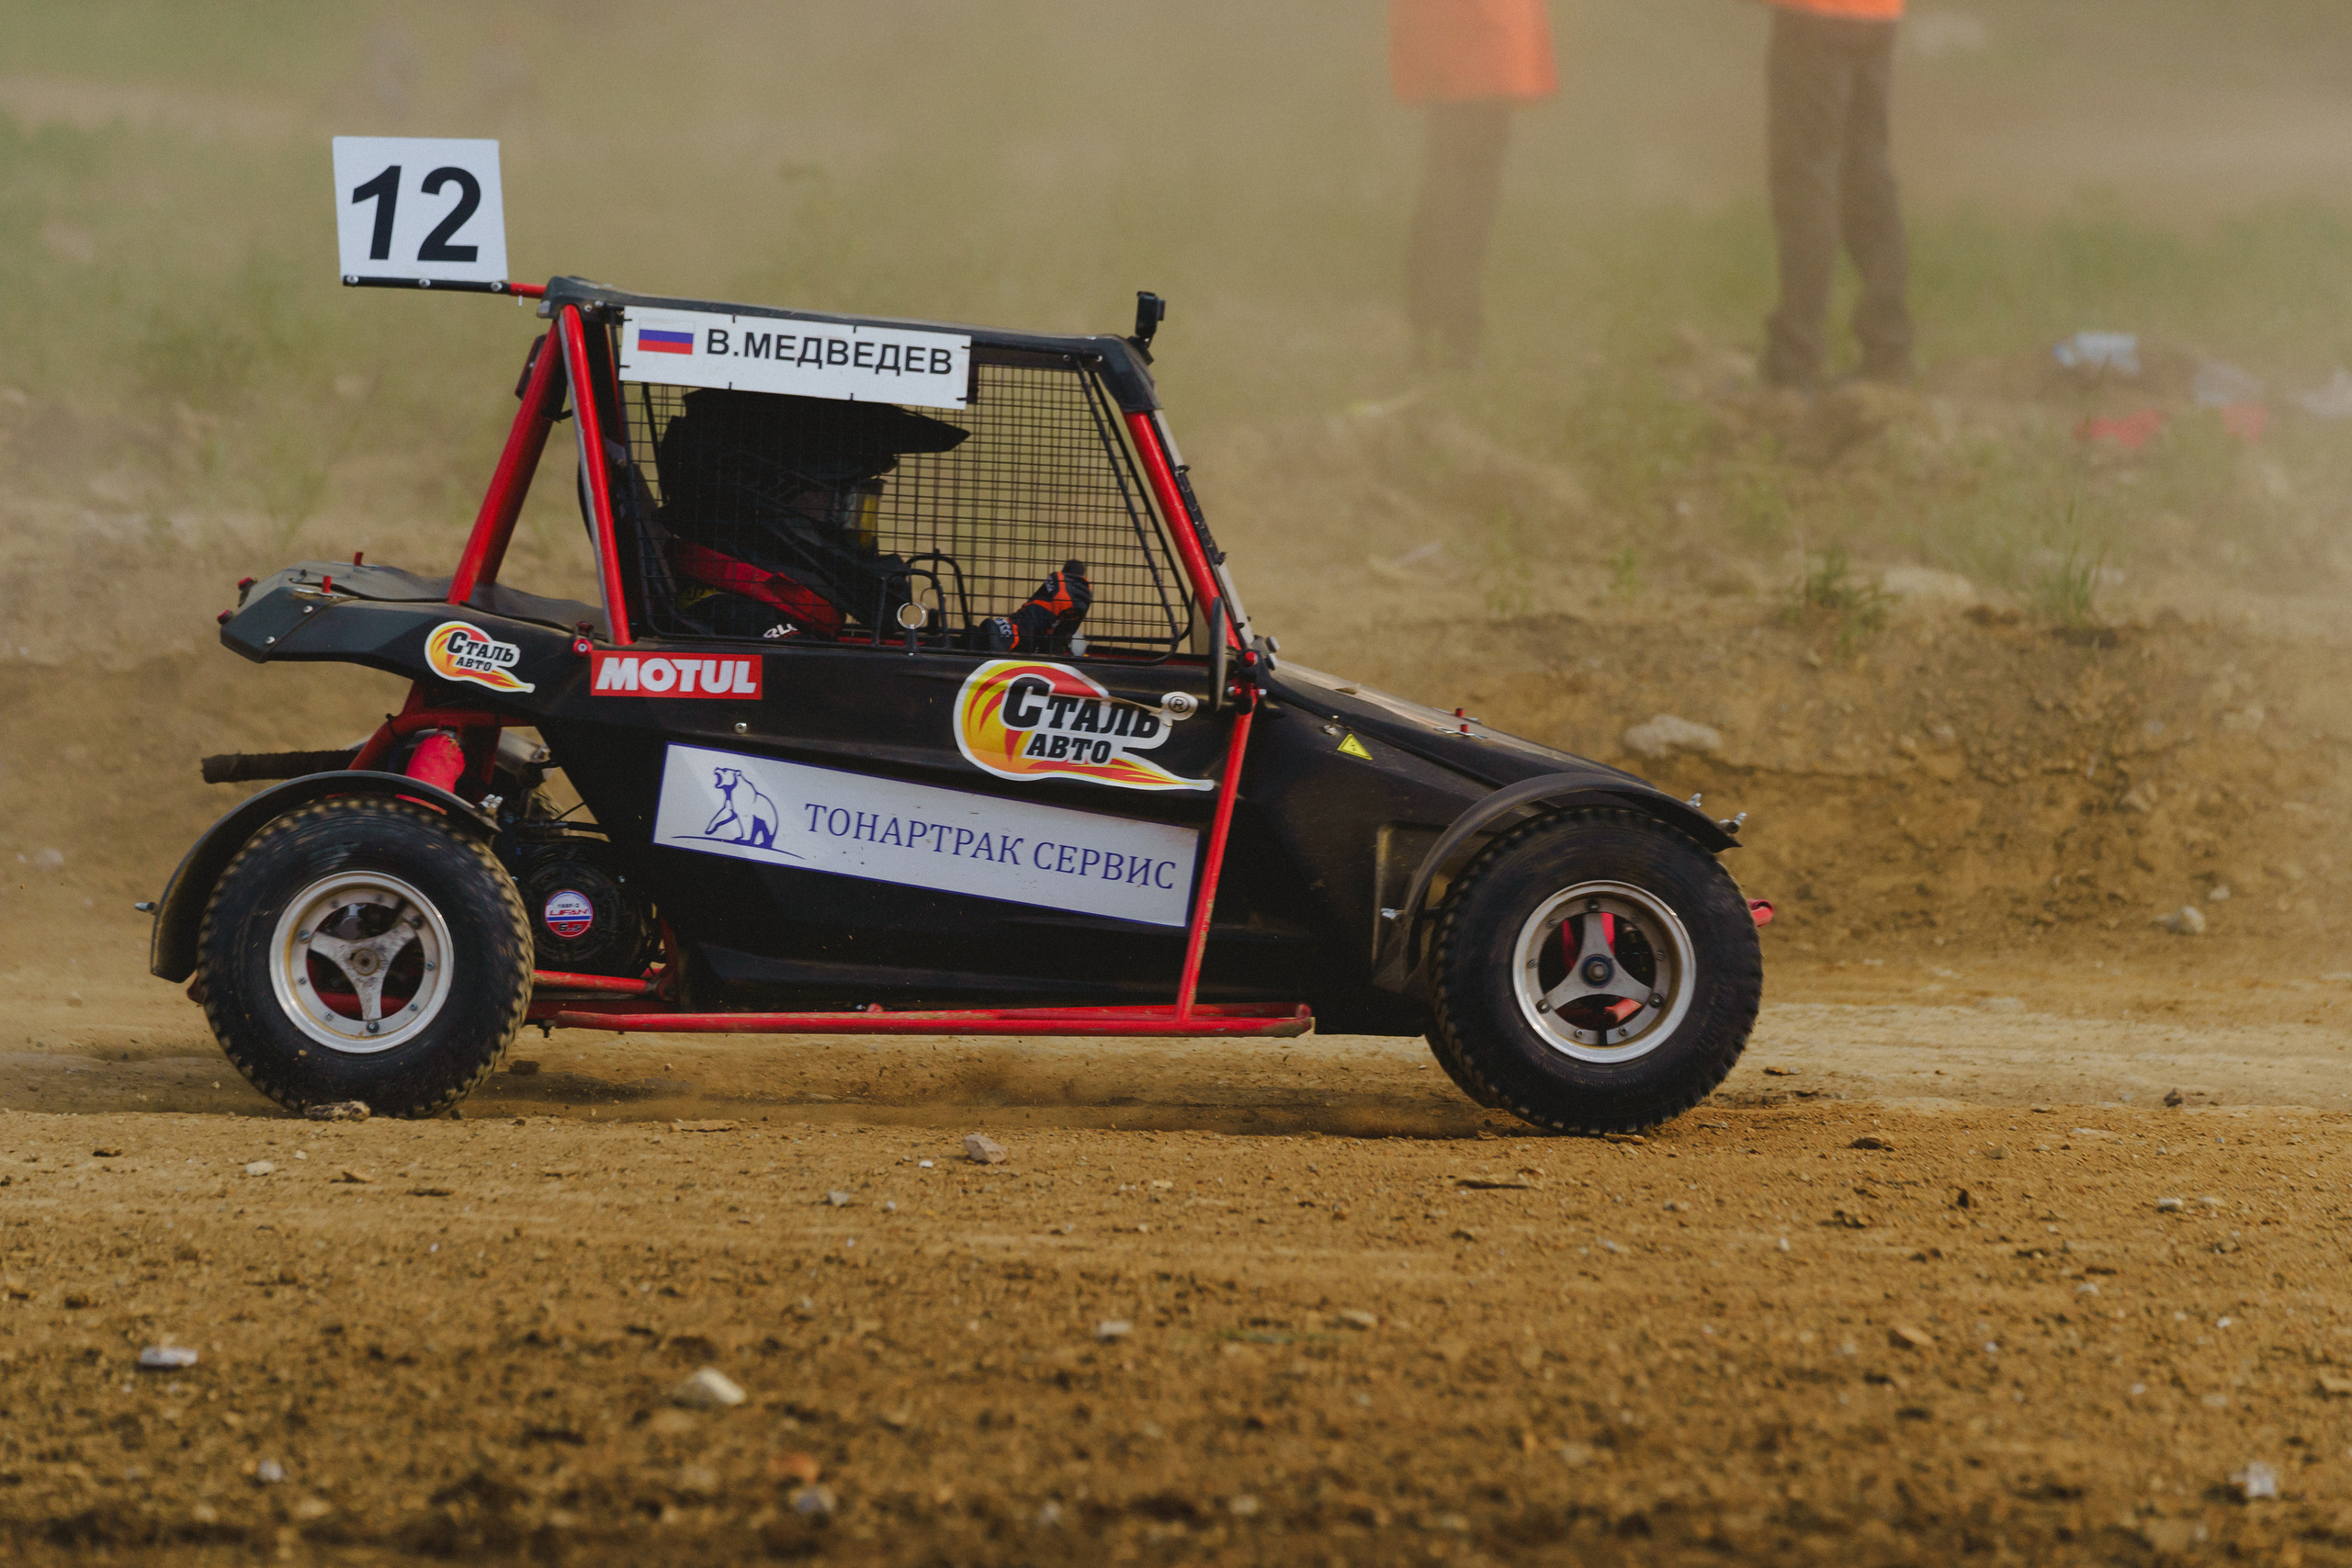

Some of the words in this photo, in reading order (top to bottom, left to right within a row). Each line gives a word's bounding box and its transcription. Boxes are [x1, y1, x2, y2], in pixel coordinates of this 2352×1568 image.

[352, 165, 481, 263] 12
[707, 328, 953, 377] В.МЕДВЕДЕВ
[456, 657, 493, 671] АВТО
[595, 657, 757, 694] MOTUL
[1026, 732, 1112, 765] АВТО
[804, 803, 1025, 866] ТОНАРТРАК
[1032, 841, 1177, 890] СЕРВИС
[559, 923, 582, 931] 6.5
